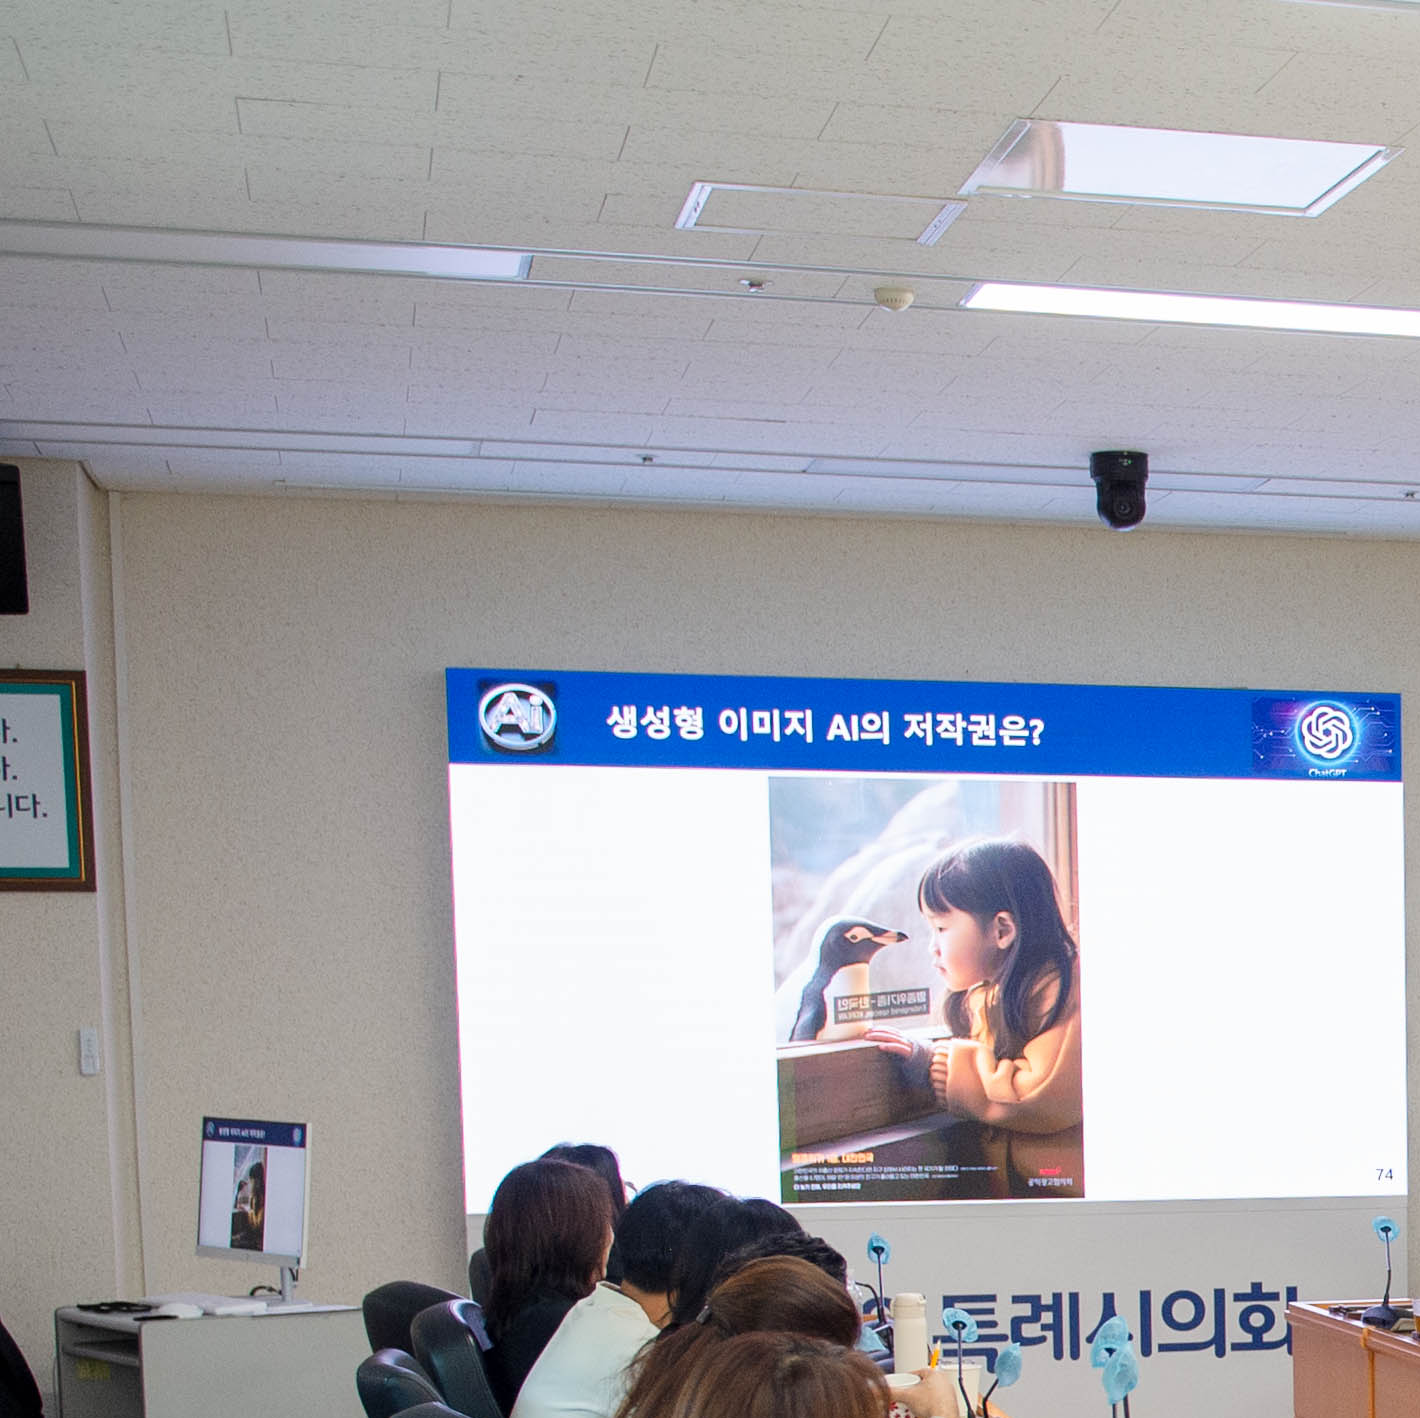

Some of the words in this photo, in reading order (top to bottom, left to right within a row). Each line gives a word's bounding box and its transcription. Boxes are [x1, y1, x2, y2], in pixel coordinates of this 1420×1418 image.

[606, 704, 705, 741] 생성형
[718, 706, 815, 744] 이미지
[826, 710, 891, 745] AI의
[903, 711, 1045, 747] 저작권은?
[1308, 768, 1347, 777] ChatGPT
[1376, 1168, 1393, 1180] 74
[863, 1281, 1297, 1373] 특례시의회
